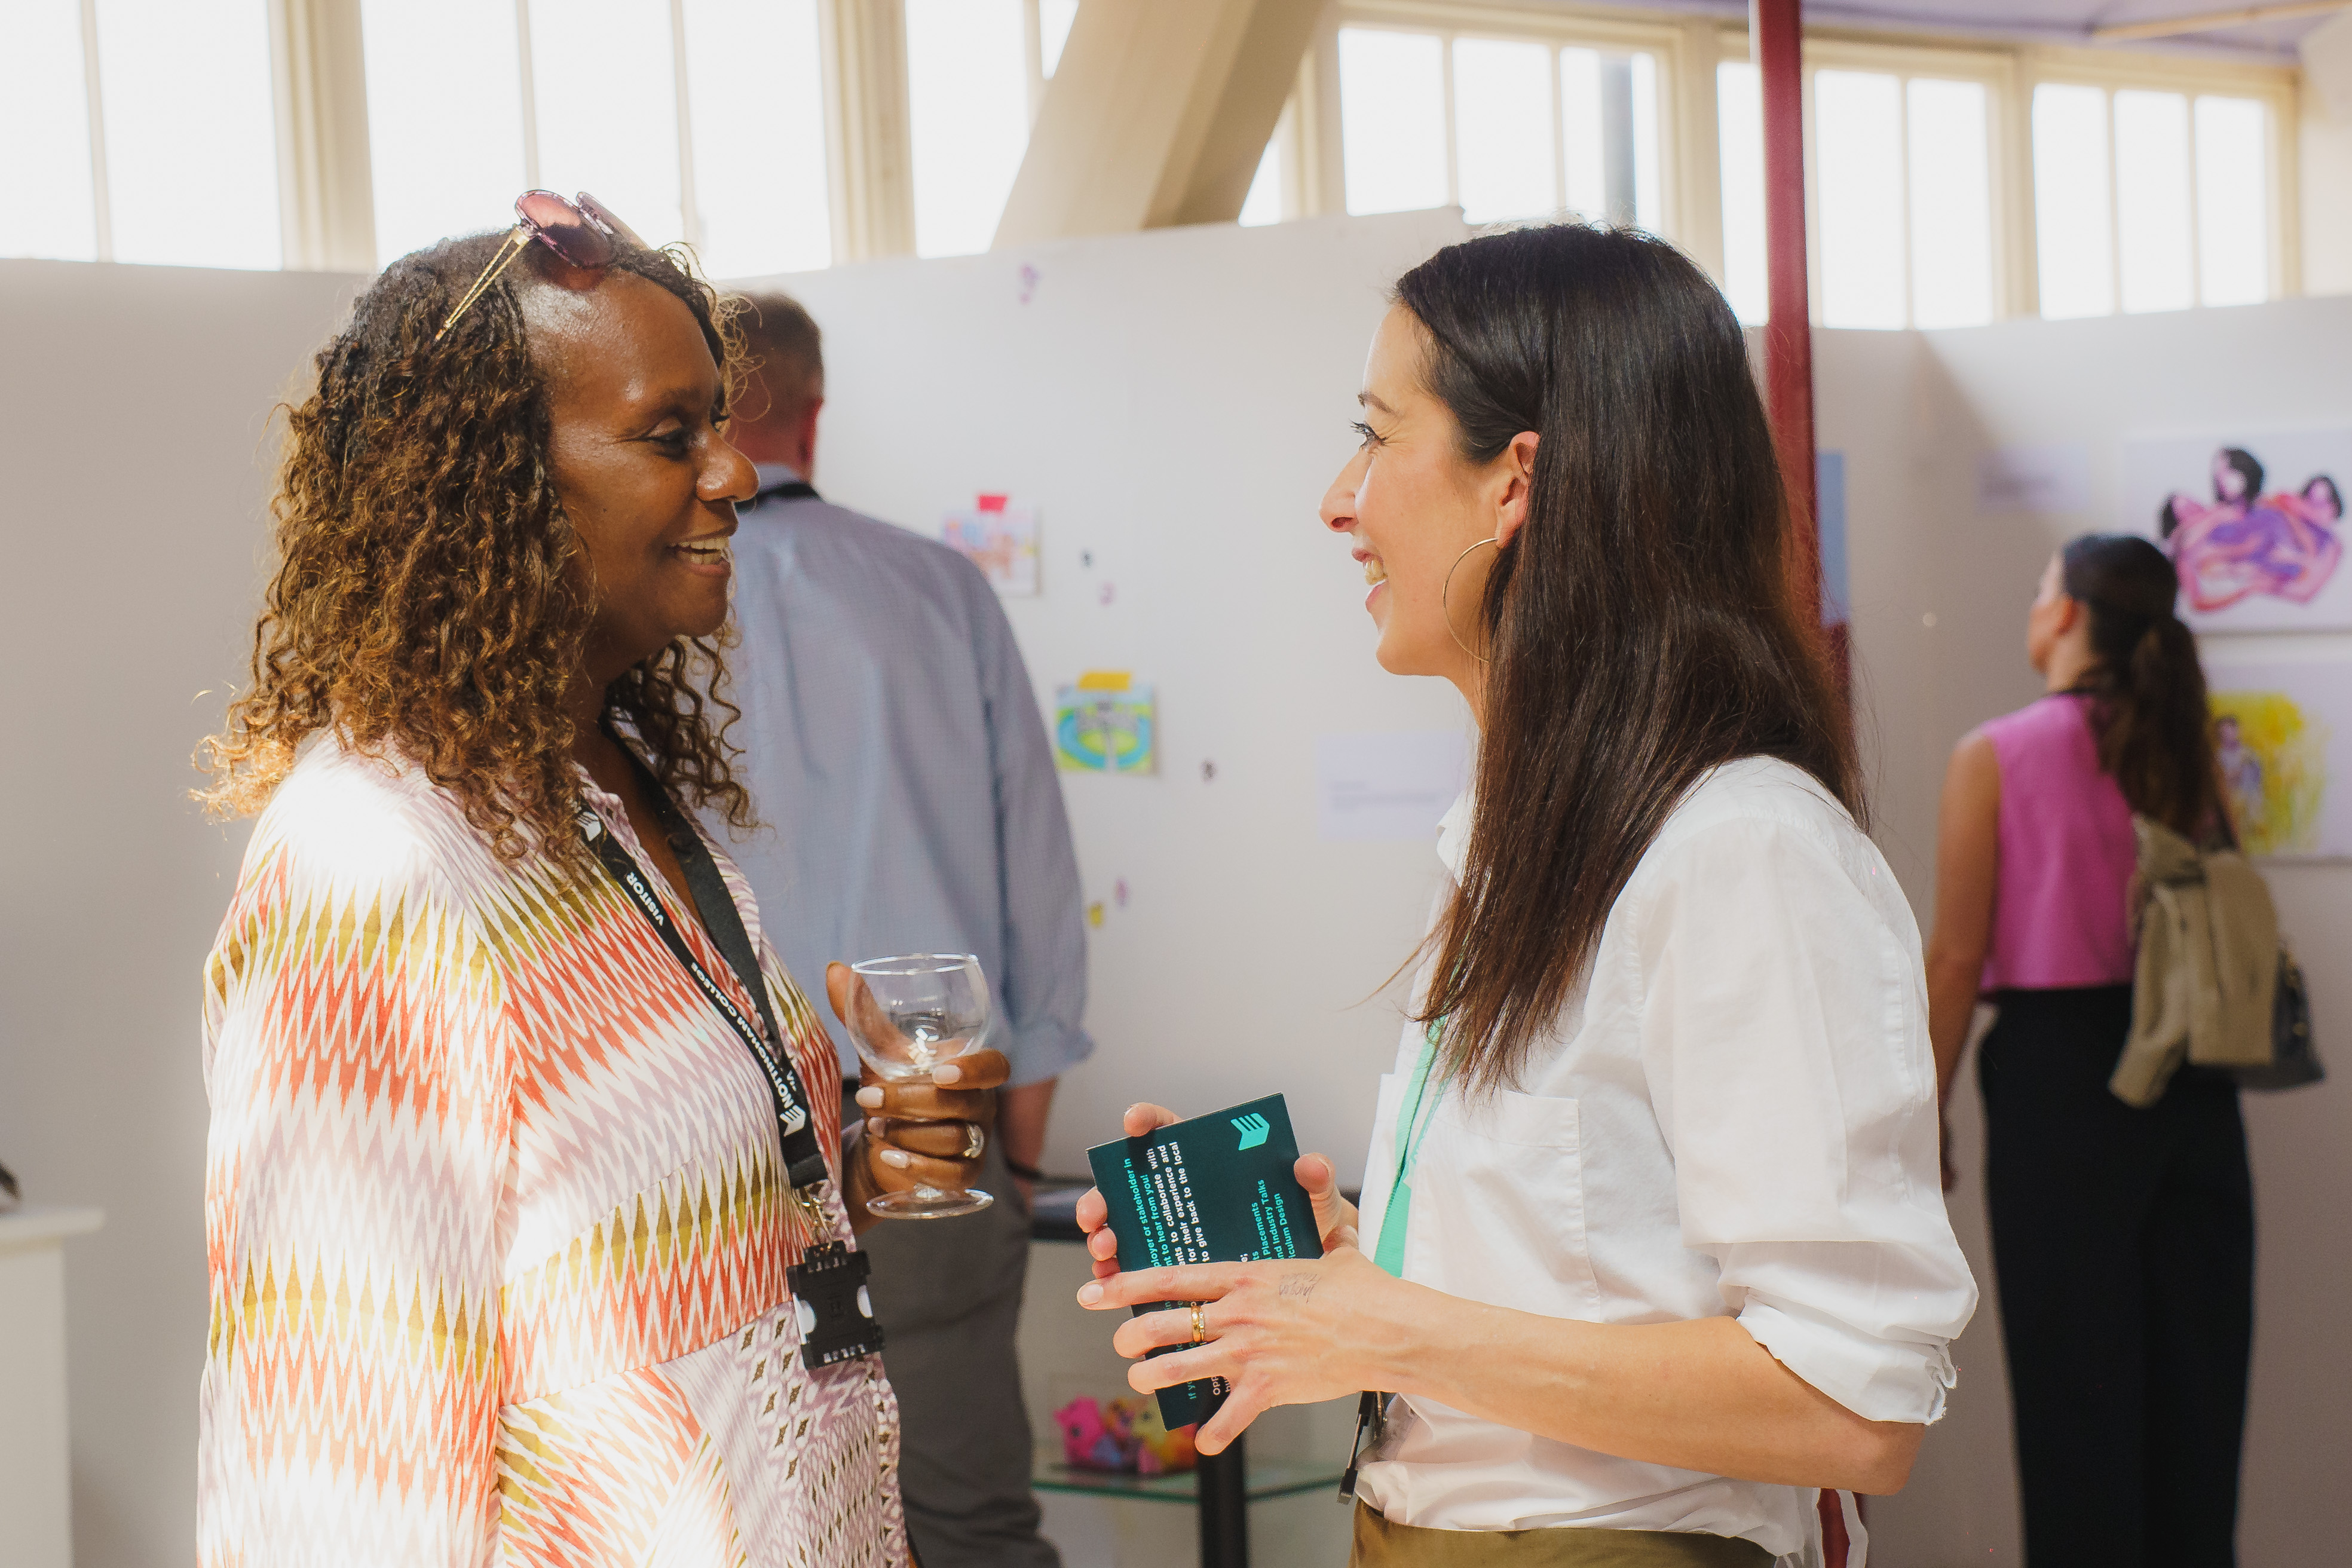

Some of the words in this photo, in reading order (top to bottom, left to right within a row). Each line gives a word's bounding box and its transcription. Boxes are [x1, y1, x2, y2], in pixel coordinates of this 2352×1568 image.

[626, 871, 664, 926] VISITOR
[691, 962, 737, 1017] COLLEGE
[737, 1016, 794, 1108] NOTTINGHAM
[1123, 1157, 1132, 1168] in
[1146, 1147, 1158, 1169] with
[1156, 1144, 1169, 1162] and
[1168, 1141, 1183, 1165] local
[1139, 1174, 1154, 1196] you!
[1177, 1167, 1188, 1184] the
[1126, 1169, 1148, 1224] stakeholder
[1153, 1173, 1175, 1226] collaborate
[1164, 1166, 1185, 1217] experience
[1183, 1186, 1192, 1198] to
[1257, 1179, 1269, 1205] Talks
[1147, 1196, 1160, 1220] from
[1186, 1199, 1199, 1224] back
[1273, 1193, 1288, 1226] Design
[1142, 1226, 1152, 1236] or
[1153, 1221, 1166, 1243] hear
[1169, 1230, 1179, 1242] to
[1179, 1221, 1192, 1244] their
[1194, 1226, 1207, 1247] give
[1251, 1202, 1271, 1256] Placements
[1264, 1206, 1280, 1245] Industry
[1148, 1238, 1162, 1267] ployer
[1160, 1243, 1169, 1255] to
[1274, 1245, 1285, 1259] nd
[1283, 1227, 1296, 1258] iculum
[1163, 1255, 1173, 1266] nt
[1174, 1247, 1185, 1265] ents
[1186, 1247, 1198, 1261] for
[1200, 1250, 1210, 1261] to
